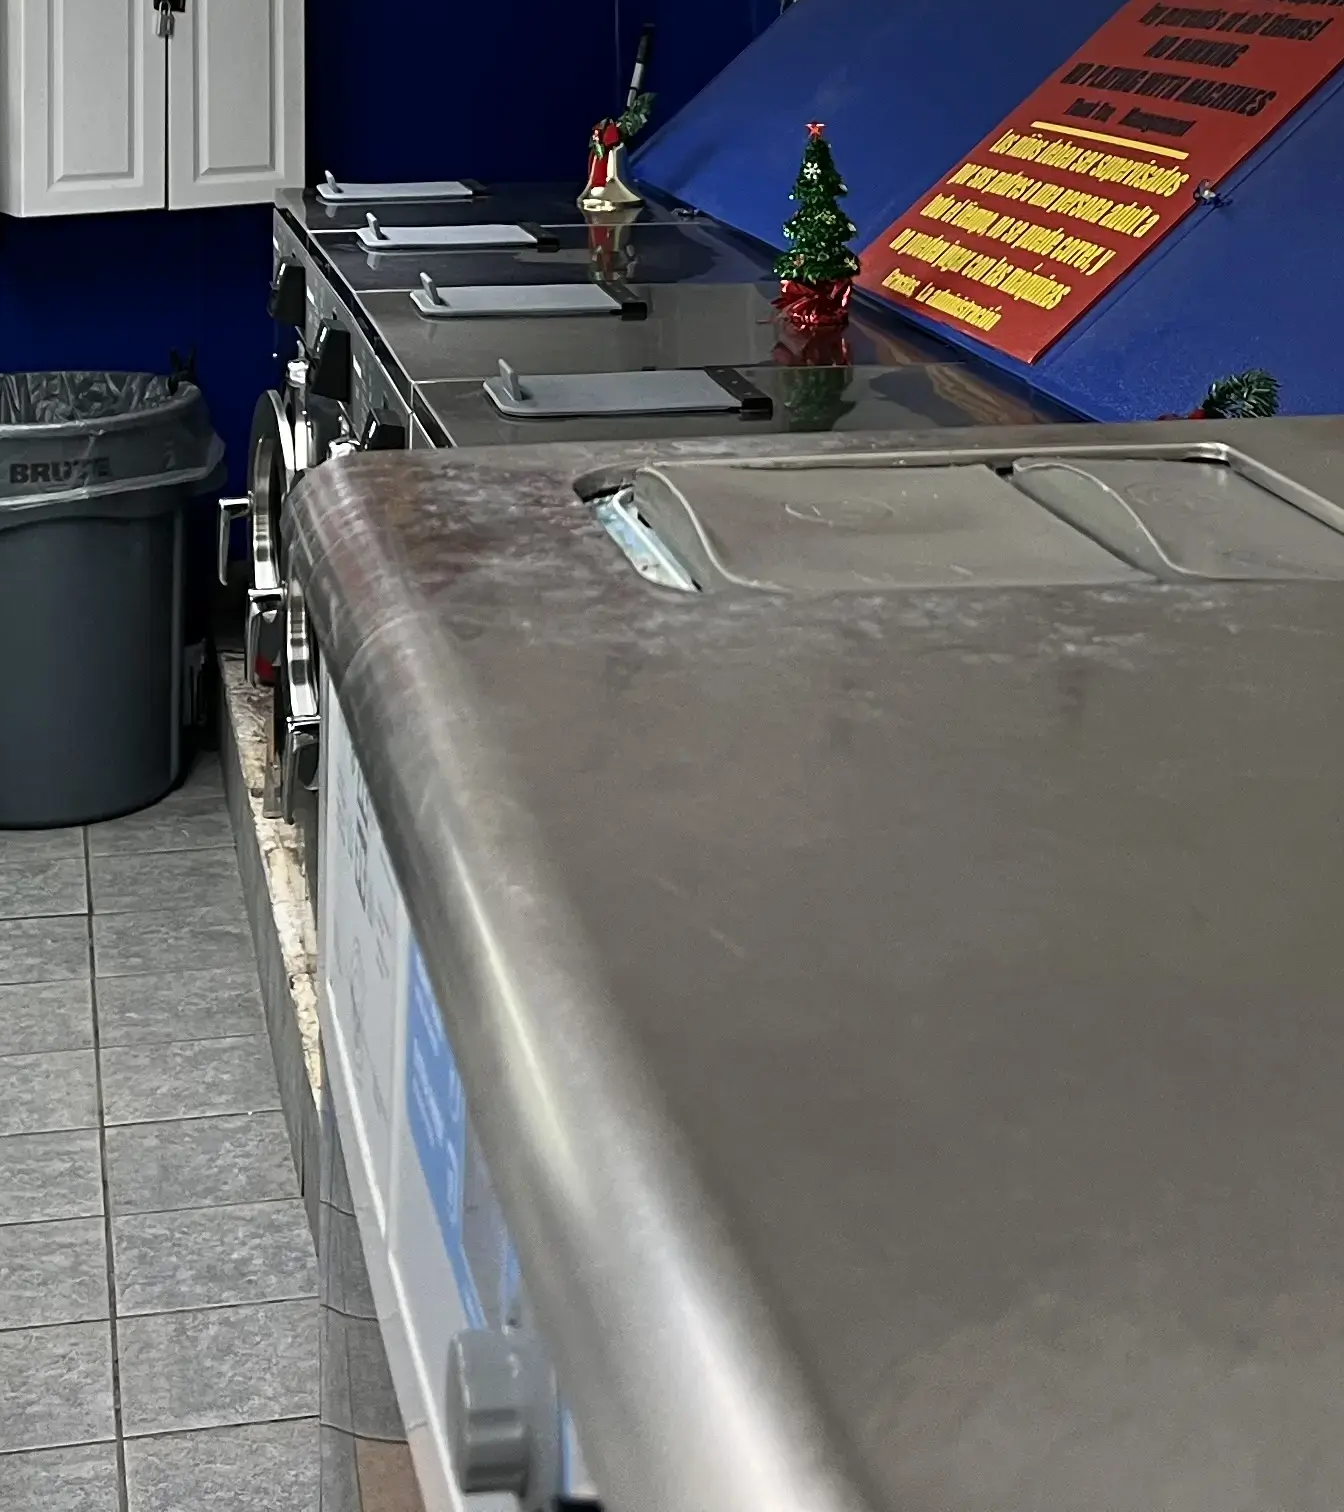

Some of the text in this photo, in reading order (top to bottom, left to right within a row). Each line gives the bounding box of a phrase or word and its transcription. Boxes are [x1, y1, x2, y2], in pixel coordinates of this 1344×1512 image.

[1175, 79, 1276, 116] MACHINES
[966, 167, 998, 189] sus
[1035, 139, 1084, 169] deben
[1069, 150, 1104, 173] ser
[1089, 155, 1189, 197] supervisados
[1020, 181, 1042, 201] o
[1028, 184, 1064, 208] una
[1046, 189, 1113, 223] persona
[986, 216, 1015, 239] no
[1000, 220, 1029, 243] se
[1011, 225, 1064, 255] puede
[962, 254, 997, 281] con
[980, 257, 1014, 287] las
[1086, 250, 1116, 275] y
